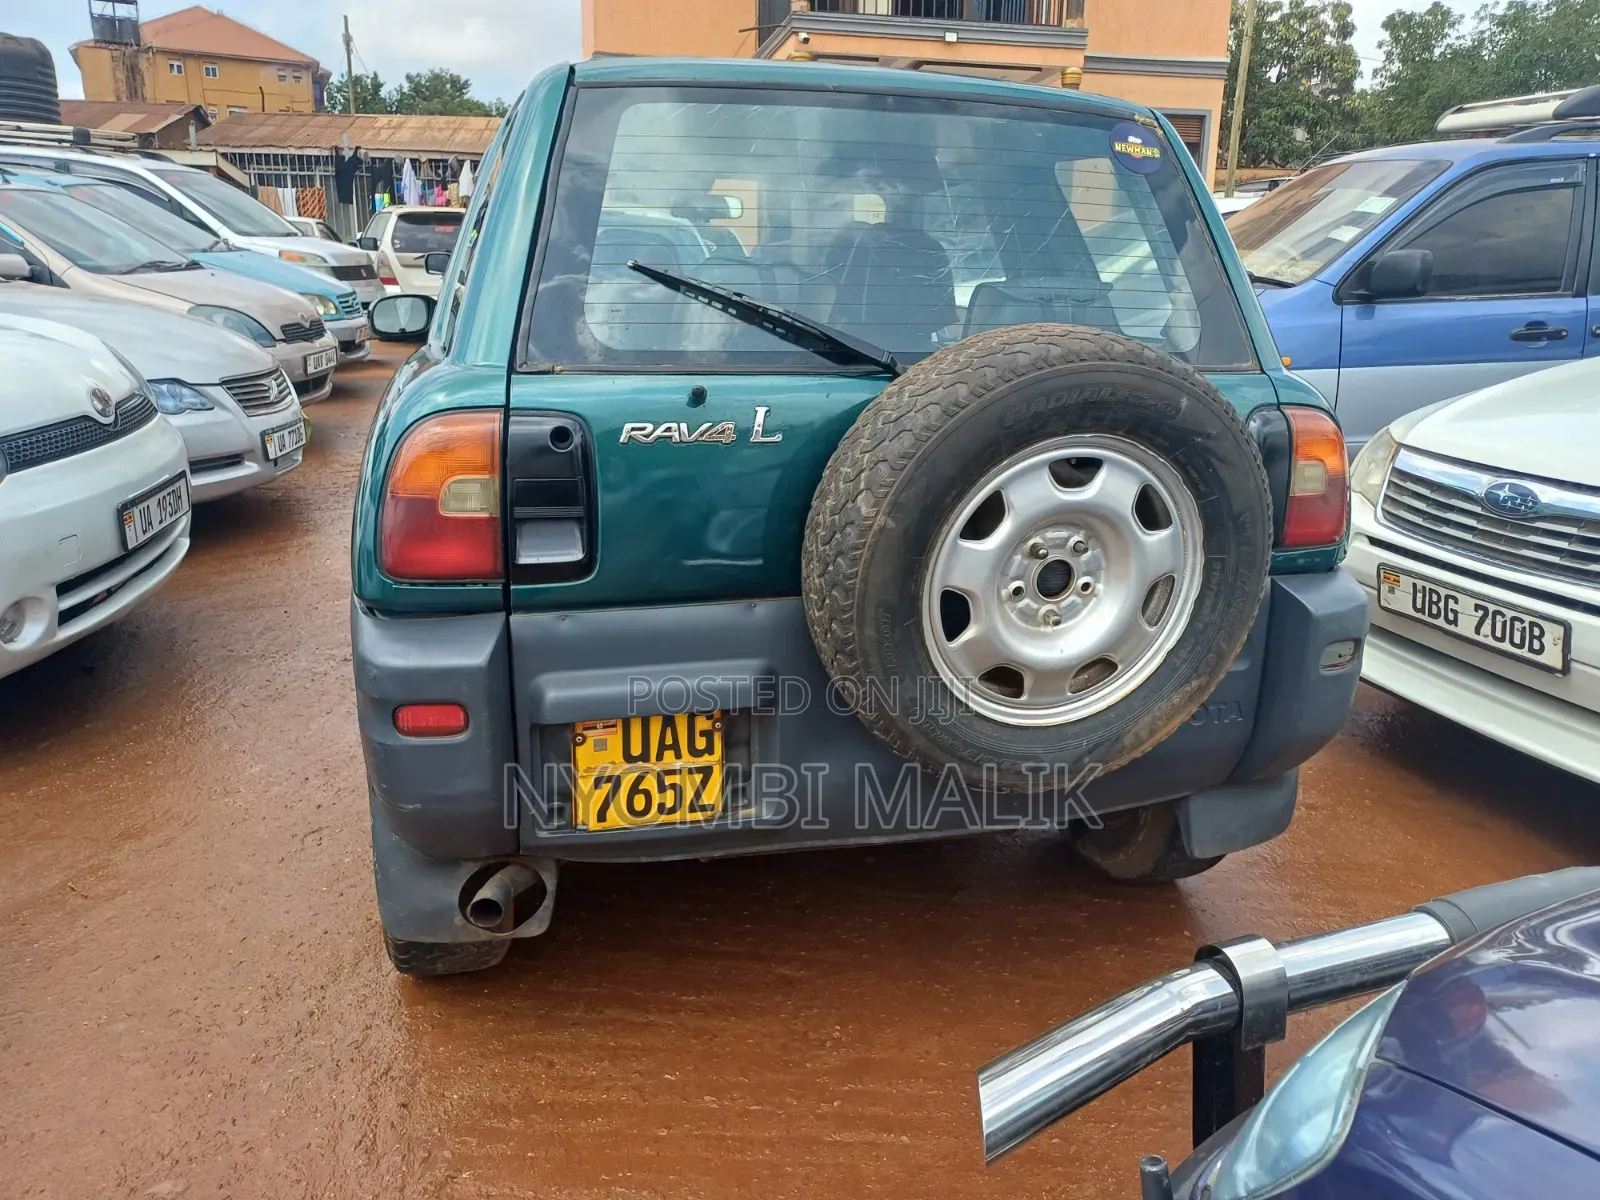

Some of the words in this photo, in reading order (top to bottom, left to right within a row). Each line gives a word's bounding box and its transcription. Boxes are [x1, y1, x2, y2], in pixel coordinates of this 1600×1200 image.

[619, 422, 737, 445] RAV4
[749, 406, 784, 444] L
[138, 504, 154, 536] UA
[156, 485, 184, 525] 193DH
[1411, 582, 1459, 628] UBG
[1473, 603, 1546, 656] 700B
[621, 711, 716, 764] UAG
[1190, 700, 1244, 726] OTA
[592, 766, 717, 824] 765Z
